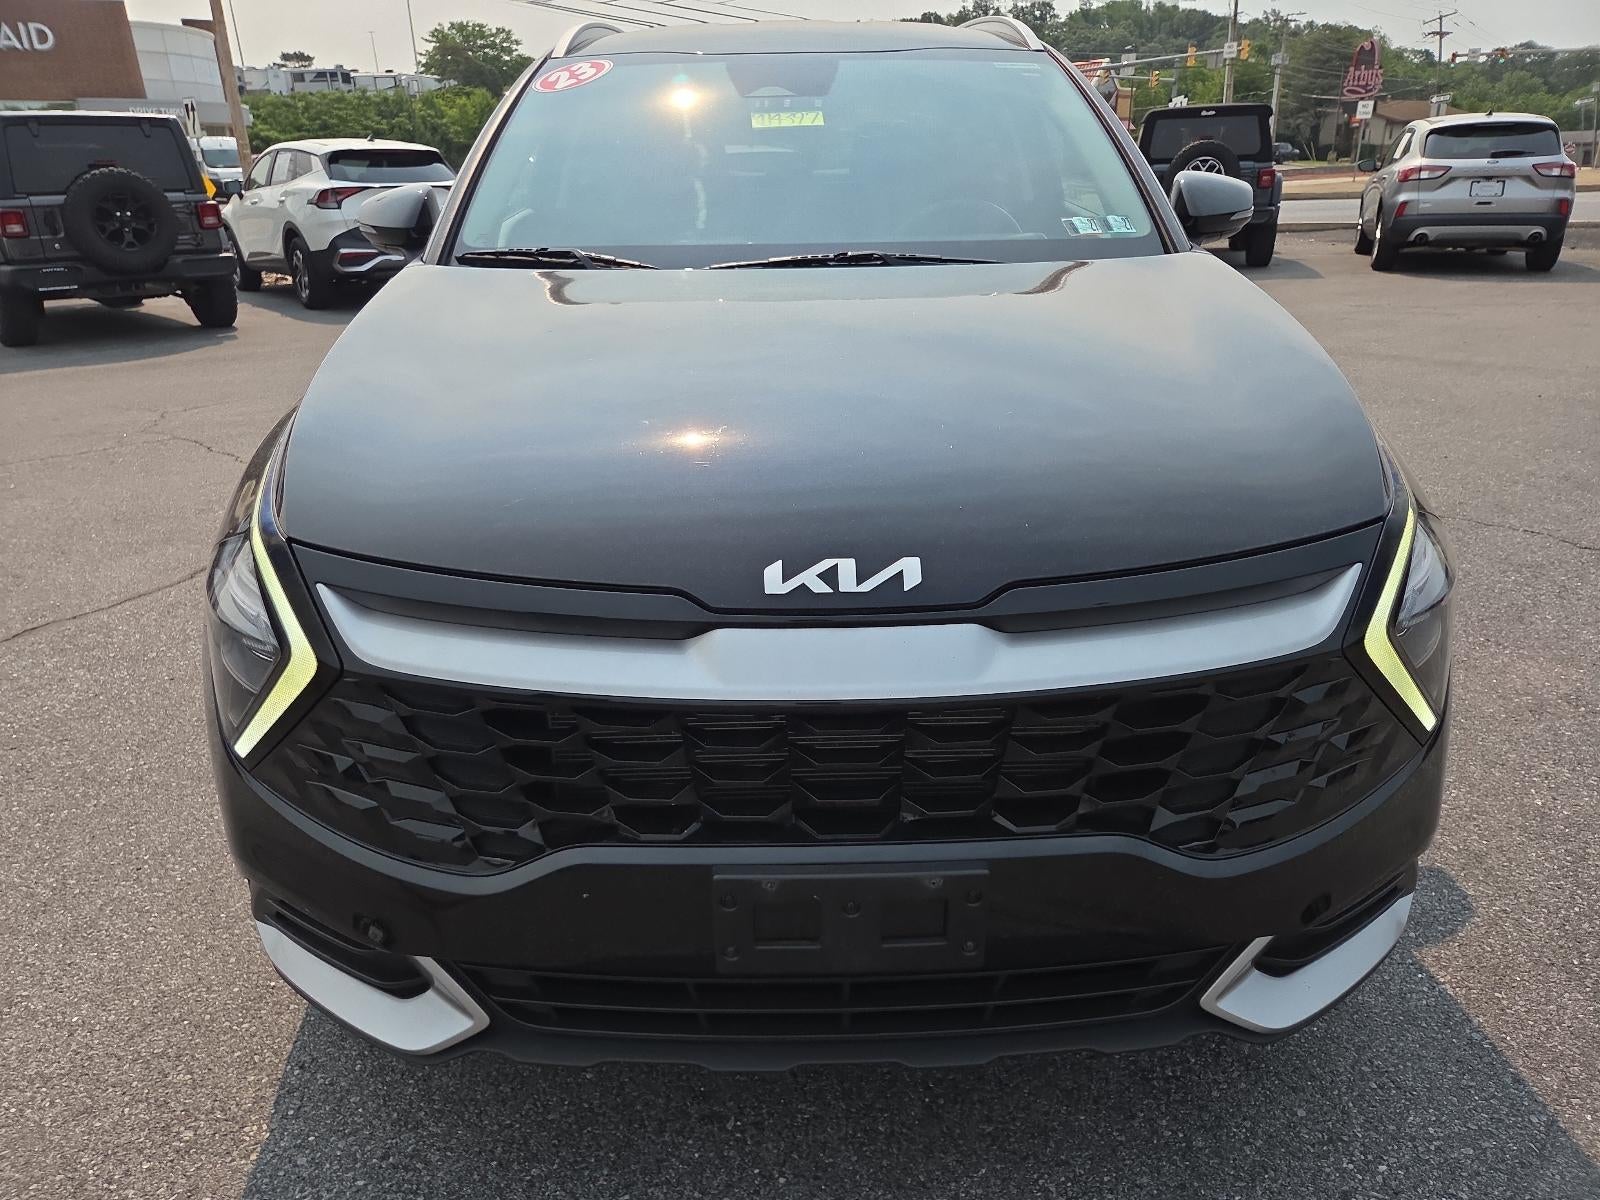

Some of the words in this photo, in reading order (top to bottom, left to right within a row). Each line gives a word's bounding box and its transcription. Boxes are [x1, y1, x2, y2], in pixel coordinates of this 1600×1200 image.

[0, 21, 54, 50] AID
[547, 62, 598, 89] 23
[1343, 65, 1385, 89] Arby's
[763, 556, 923, 595] KIA
